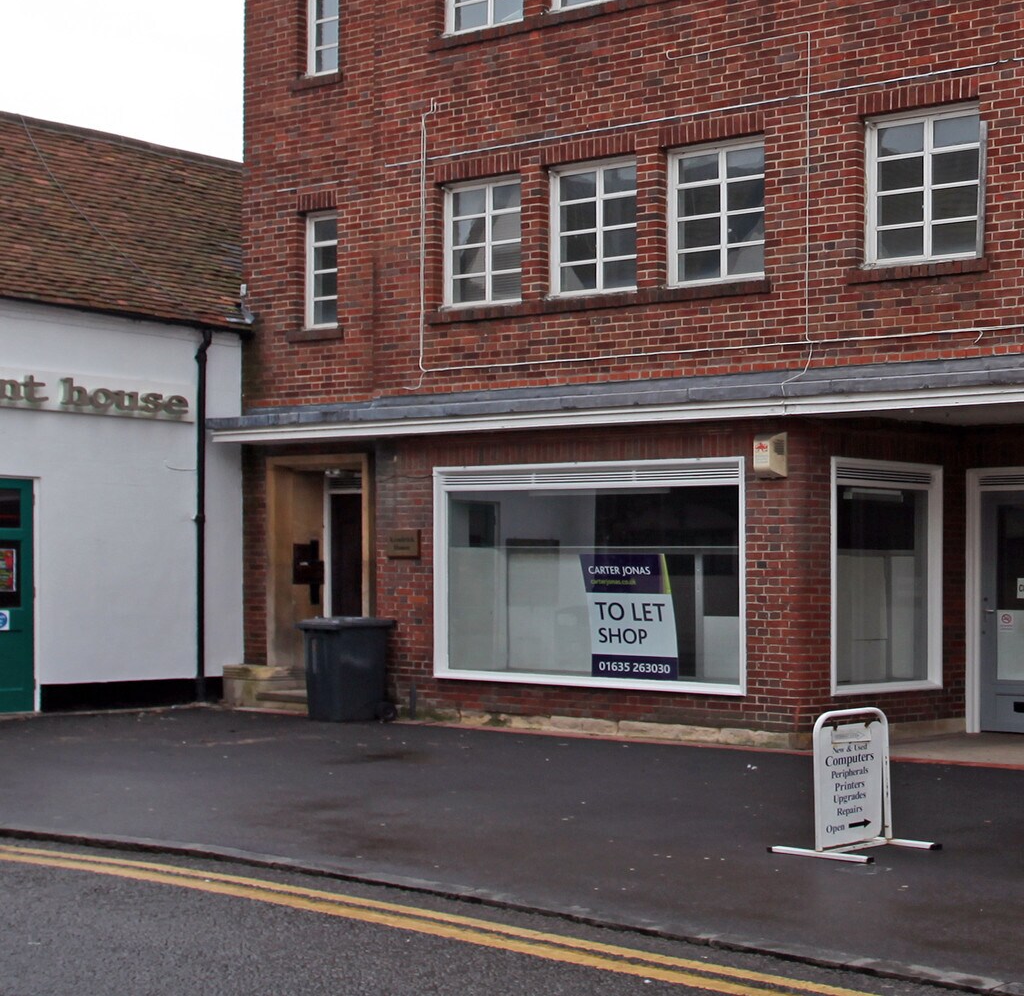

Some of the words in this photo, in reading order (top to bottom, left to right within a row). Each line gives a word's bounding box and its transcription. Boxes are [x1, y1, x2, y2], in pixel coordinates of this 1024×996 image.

[60, 377, 189, 414] house
[588, 565, 621, 575] CARTER
[622, 566, 651, 577] JONAS
[595, 602, 625, 621] TO
[631, 603, 665, 622] LET
[598, 627, 648, 645] SHOP
[598, 661, 631, 672] 01635
[632, 662, 671, 674] 263030
[825, 752, 875, 767] Computers
[831, 766, 869, 779] Peripherals
[835, 780, 865, 792] Printers
[833, 791, 867, 805] Upgrades
[836, 805, 863, 817] Repairs
[826, 824, 845, 835] Open
